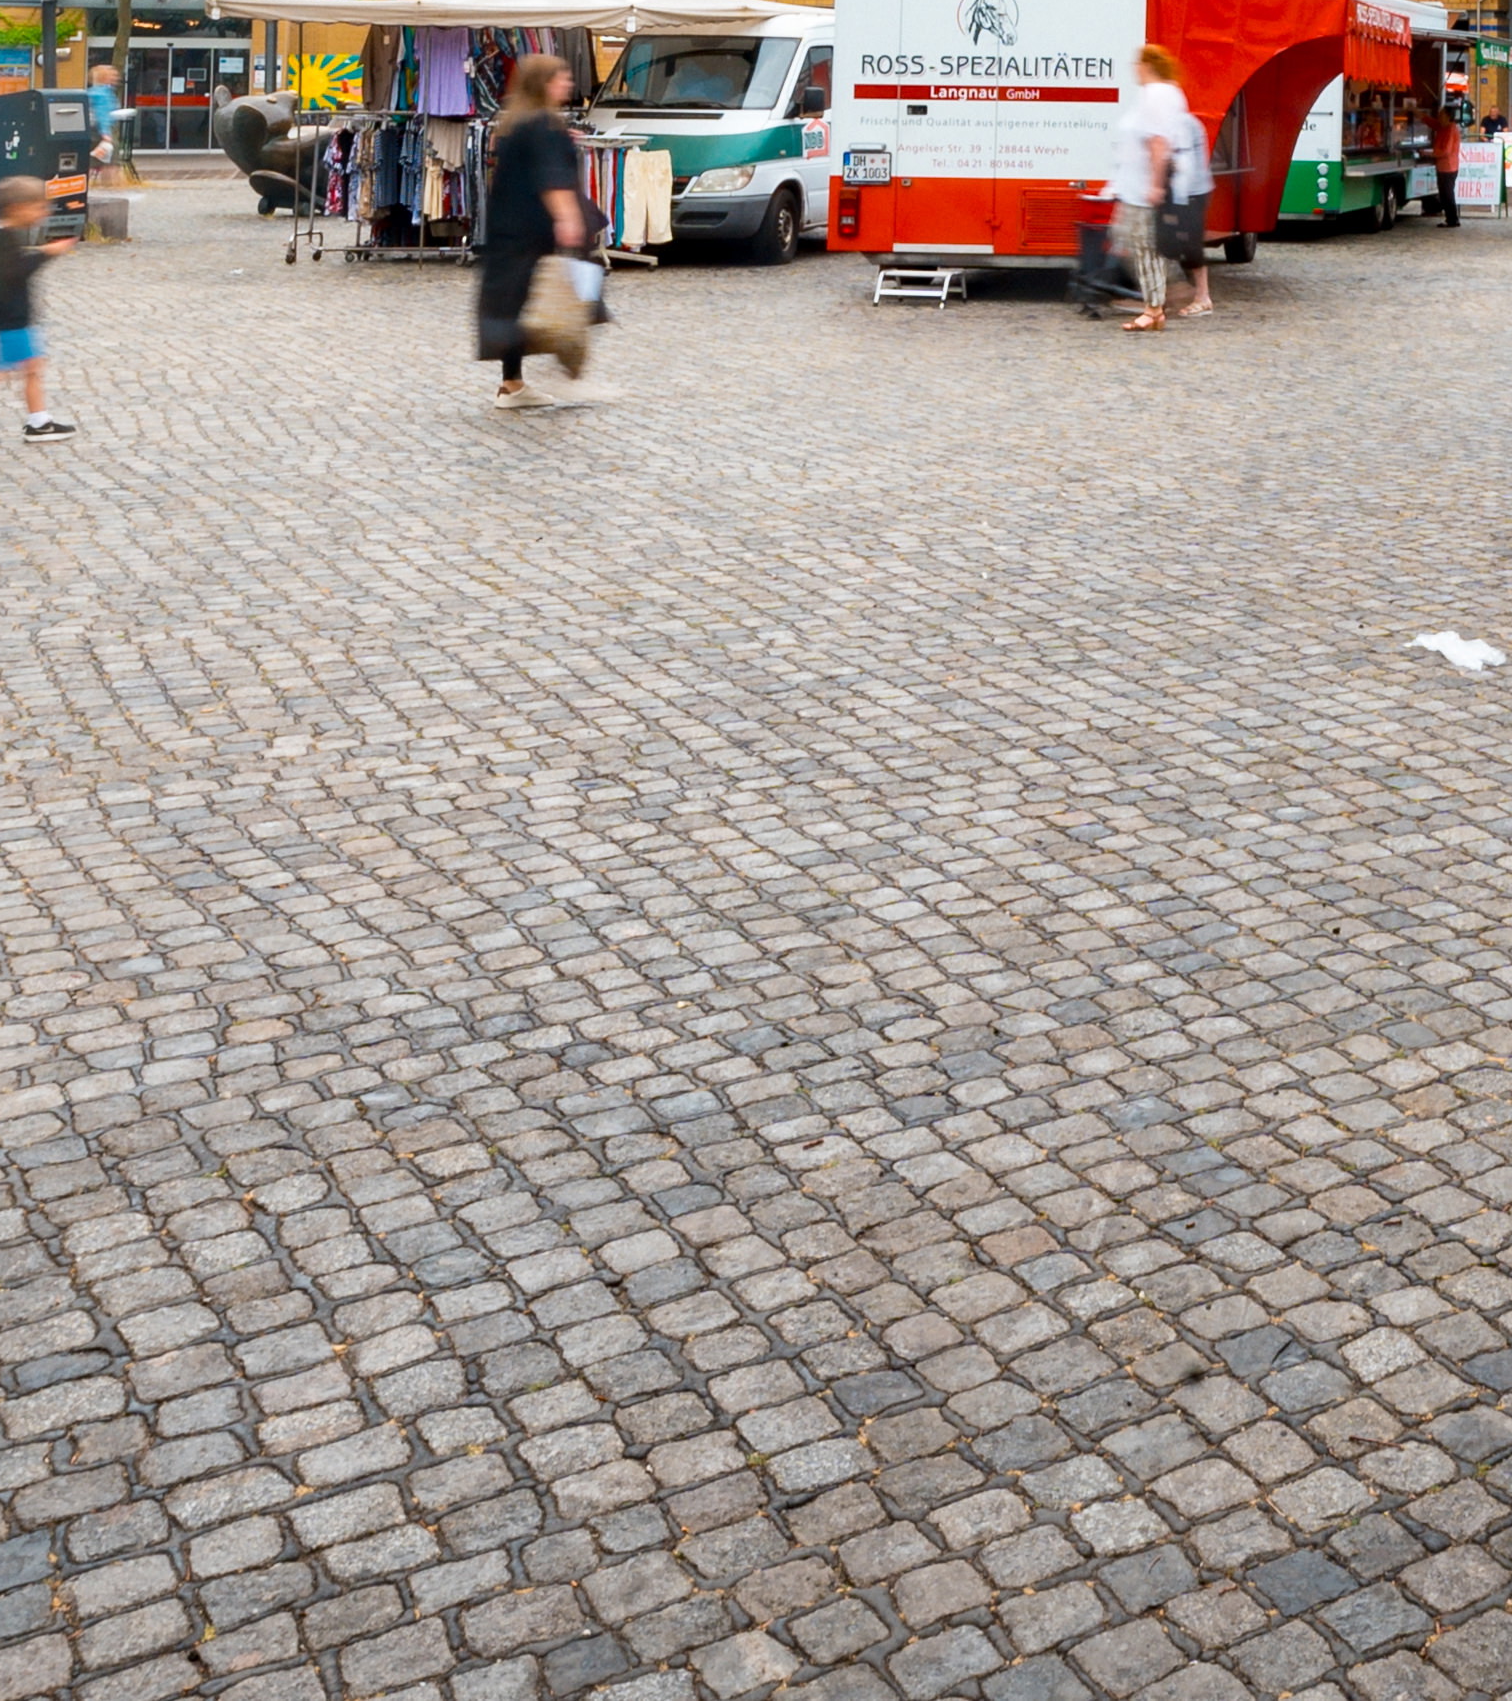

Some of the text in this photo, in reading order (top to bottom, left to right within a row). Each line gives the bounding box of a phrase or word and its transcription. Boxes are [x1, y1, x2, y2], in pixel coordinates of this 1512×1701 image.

[929, 85, 1040, 101] Langnau GmbH
[859, 116, 1109, 132] Frische und Qualität aus eigener Herstellung
[969, 144, 982, 154] 39
[998, 145, 1031, 155] 28844
[1034, 145, 1070, 157] Weyhe
[852, 155, 867, 167] DH
[846, 167, 888, 179] ZK 1003
[1457, 180, 1483, 198] HIER
